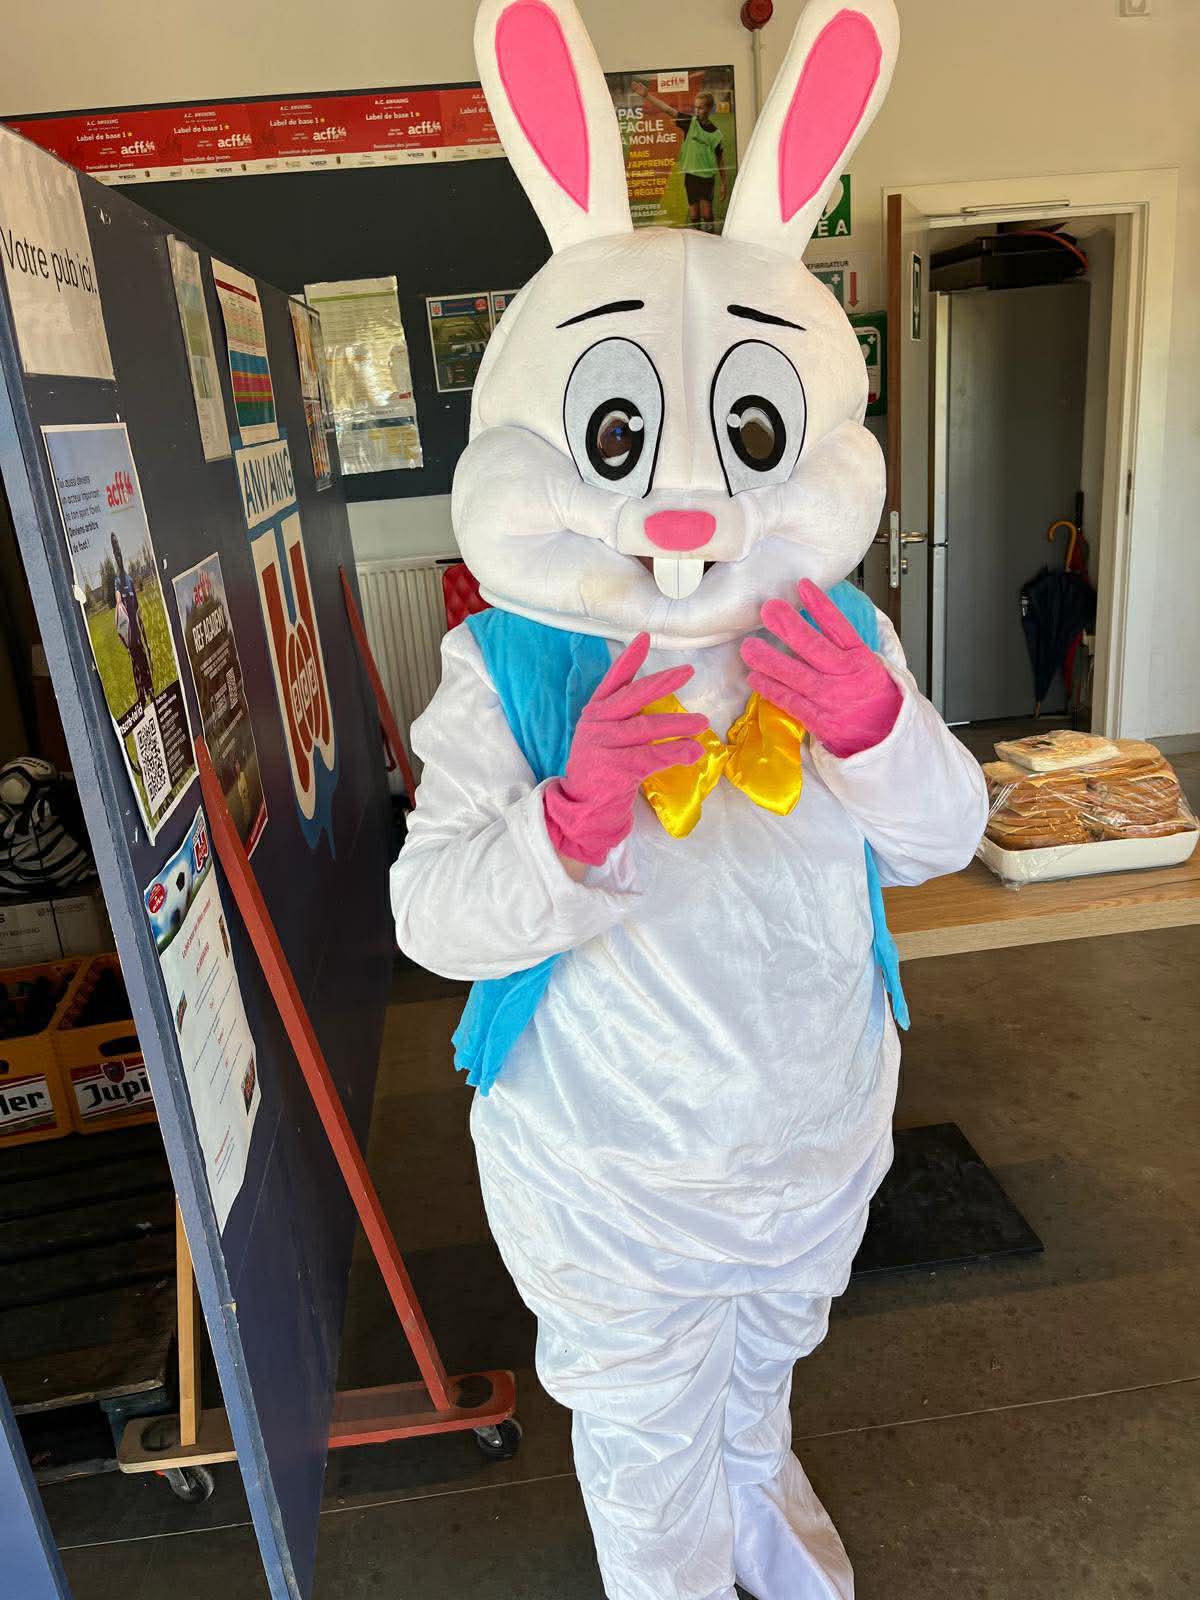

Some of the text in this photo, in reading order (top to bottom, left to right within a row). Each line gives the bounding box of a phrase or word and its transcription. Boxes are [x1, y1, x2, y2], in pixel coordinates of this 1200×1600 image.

[460, 106, 477, 114] Label
[618, 108, 644, 120] PAS
[269, 119, 287, 127] Label
[288, 118, 297, 126] de
[298, 117, 314, 125] base
[408, 121, 433, 135] acff
[619, 120, 665, 134] FACILE
[173, 126, 191, 134] Label
[313, 127, 337, 141] acff
[76, 134, 94, 142] Label
[217, 134, 242, 148] acff
[629, 134, 654, 145] MON
[121, 141, 145, 155] acff
[626, 178, 667, 188] ESPECTER
[817, 219, 849, 236] EA
[0, 226, 49, 279] Votre
[51, 247, 79, 293] pub
[242, 447, 295, 519] ANVAING
[81, 1071, 150, 1110] Jupi
